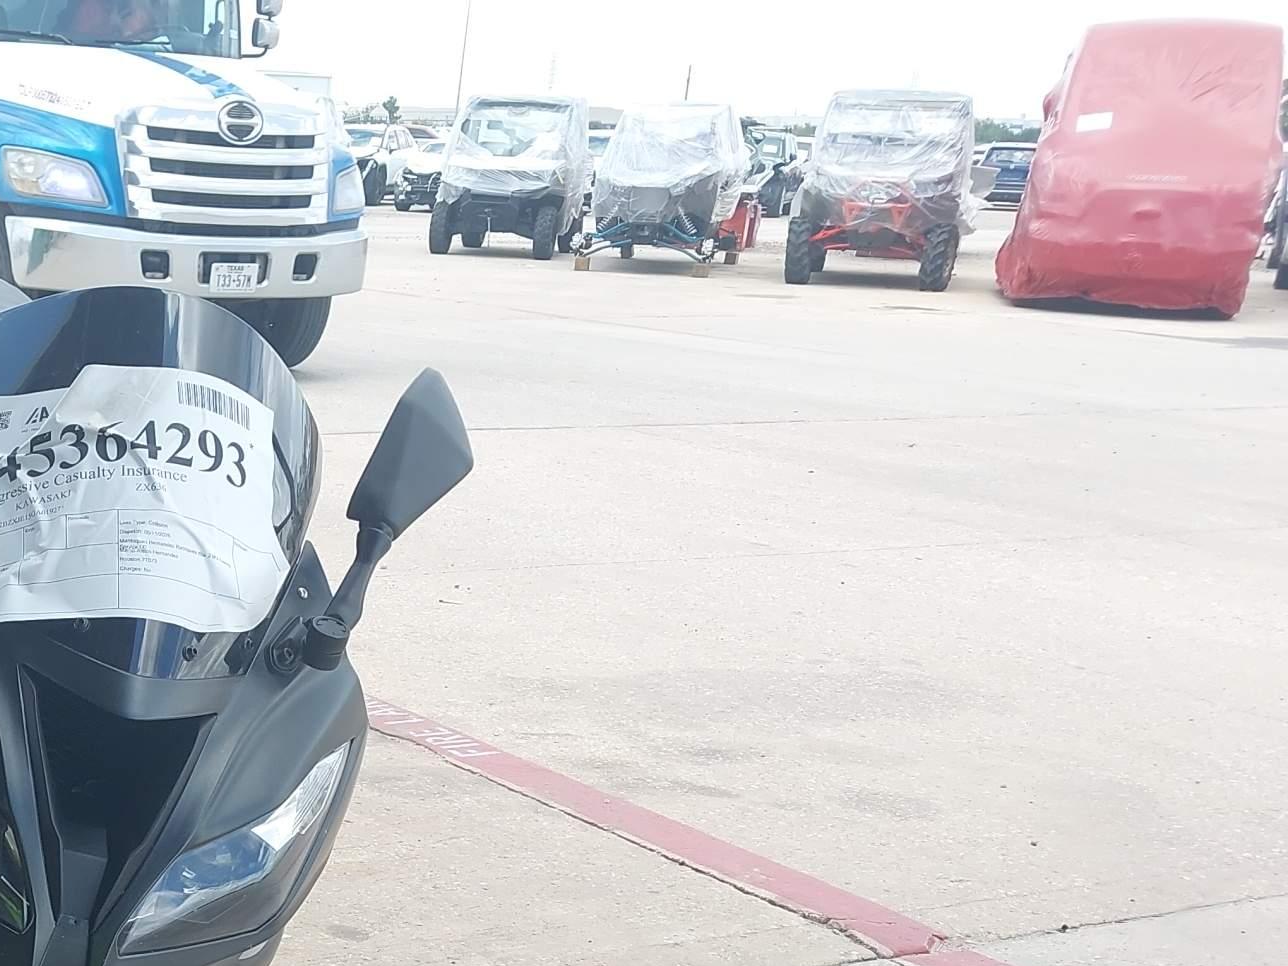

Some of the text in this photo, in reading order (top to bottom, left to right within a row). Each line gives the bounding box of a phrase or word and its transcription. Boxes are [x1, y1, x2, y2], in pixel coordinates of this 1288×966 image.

[54, 466, 115, 486] Casualty
[121, 464, 188, 482] Insurance
[15, 489, 72, 511] KAWASAKI
